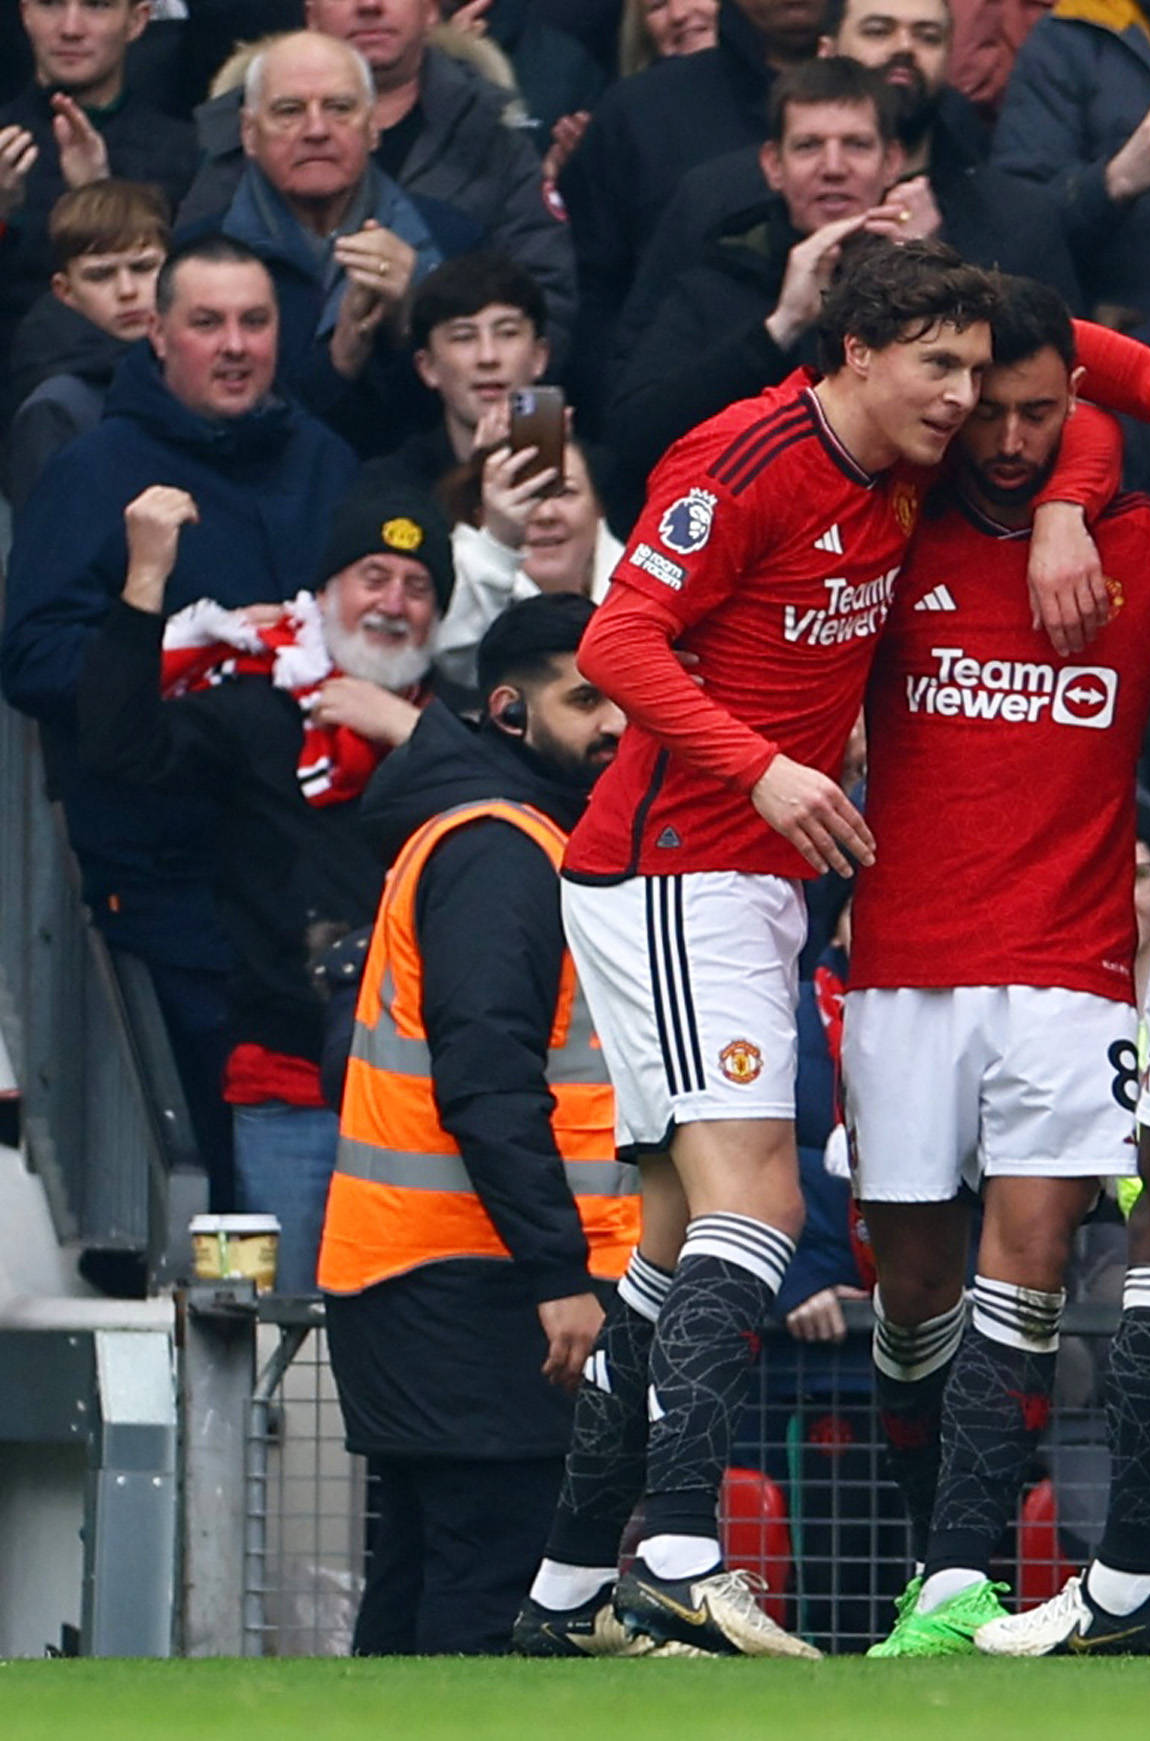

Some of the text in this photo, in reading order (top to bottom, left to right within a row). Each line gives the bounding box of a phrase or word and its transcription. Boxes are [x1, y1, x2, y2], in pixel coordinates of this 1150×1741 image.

[824, 577, 883, 616] Team
[784, 604, 880, 646] Viewer
[930, 647, 1053, 693] Team
[905, 674, 1050, 723] Viewer
[1106, 1038, 1140, 1114] 8
